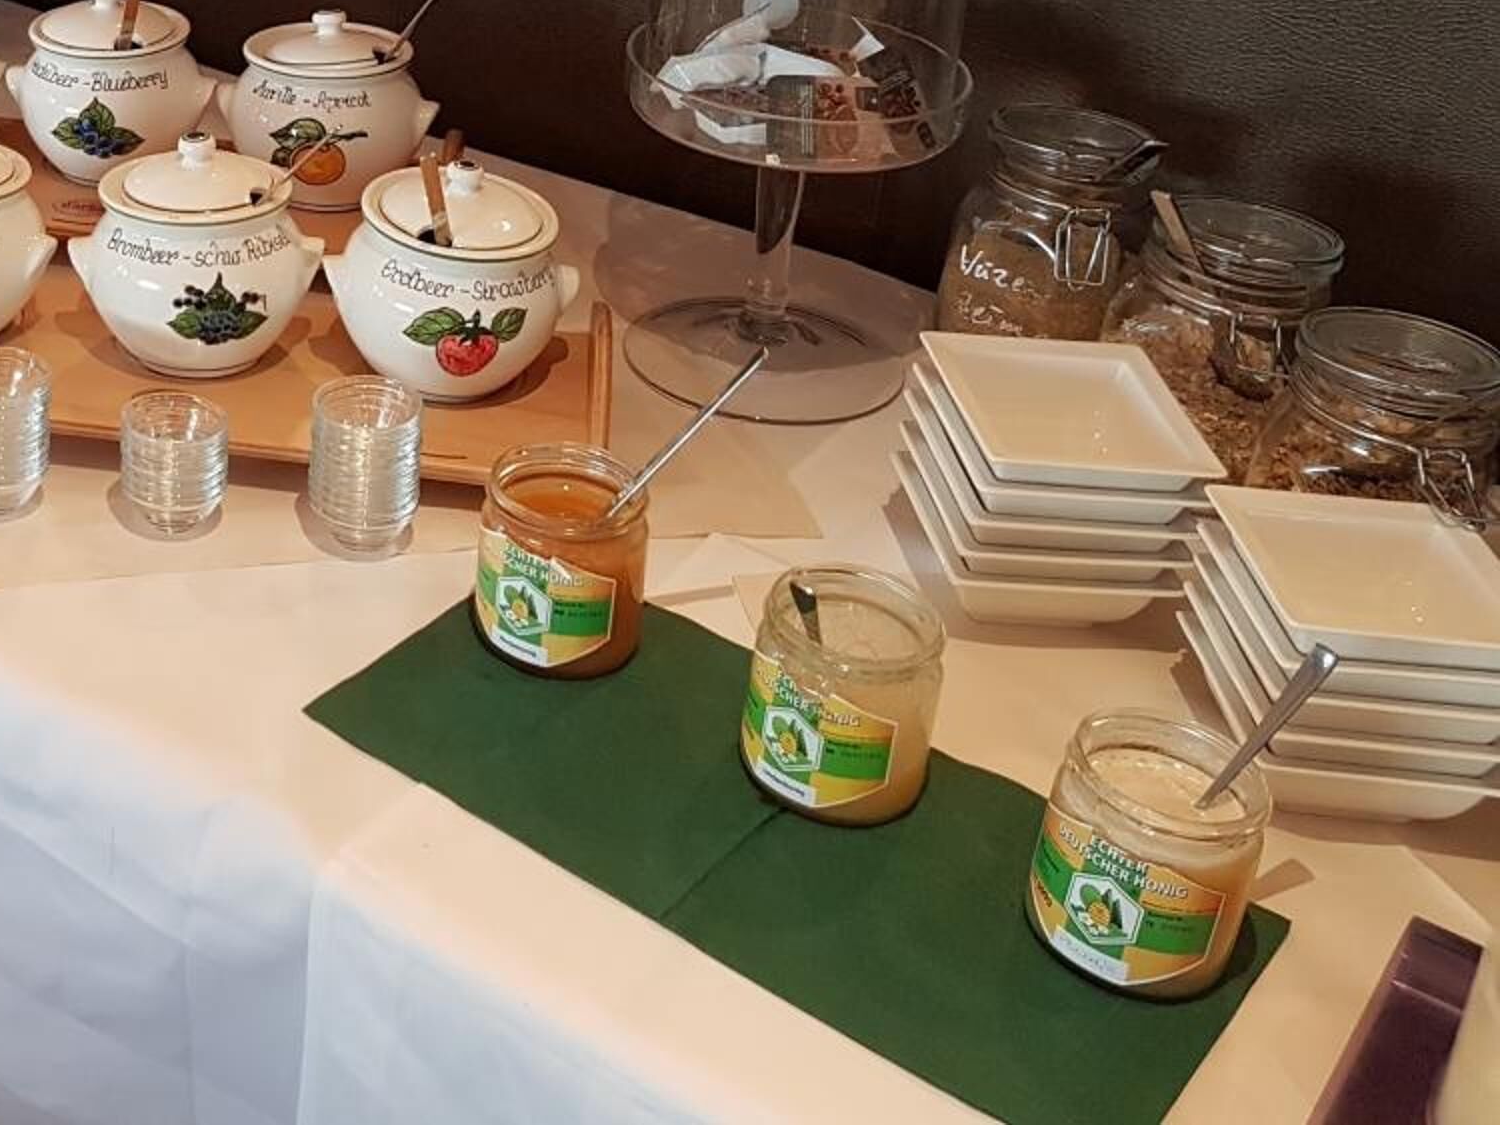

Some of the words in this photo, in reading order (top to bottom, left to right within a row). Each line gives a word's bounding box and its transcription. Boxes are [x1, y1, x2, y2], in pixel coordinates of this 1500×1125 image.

[107, 227, 179, 266] Brombeer
[381, 258, 455, 298] Erdbeer
[1090, 834, 1149, 874] ECHTER
[1133, 873, 1189, 900] HONIG
